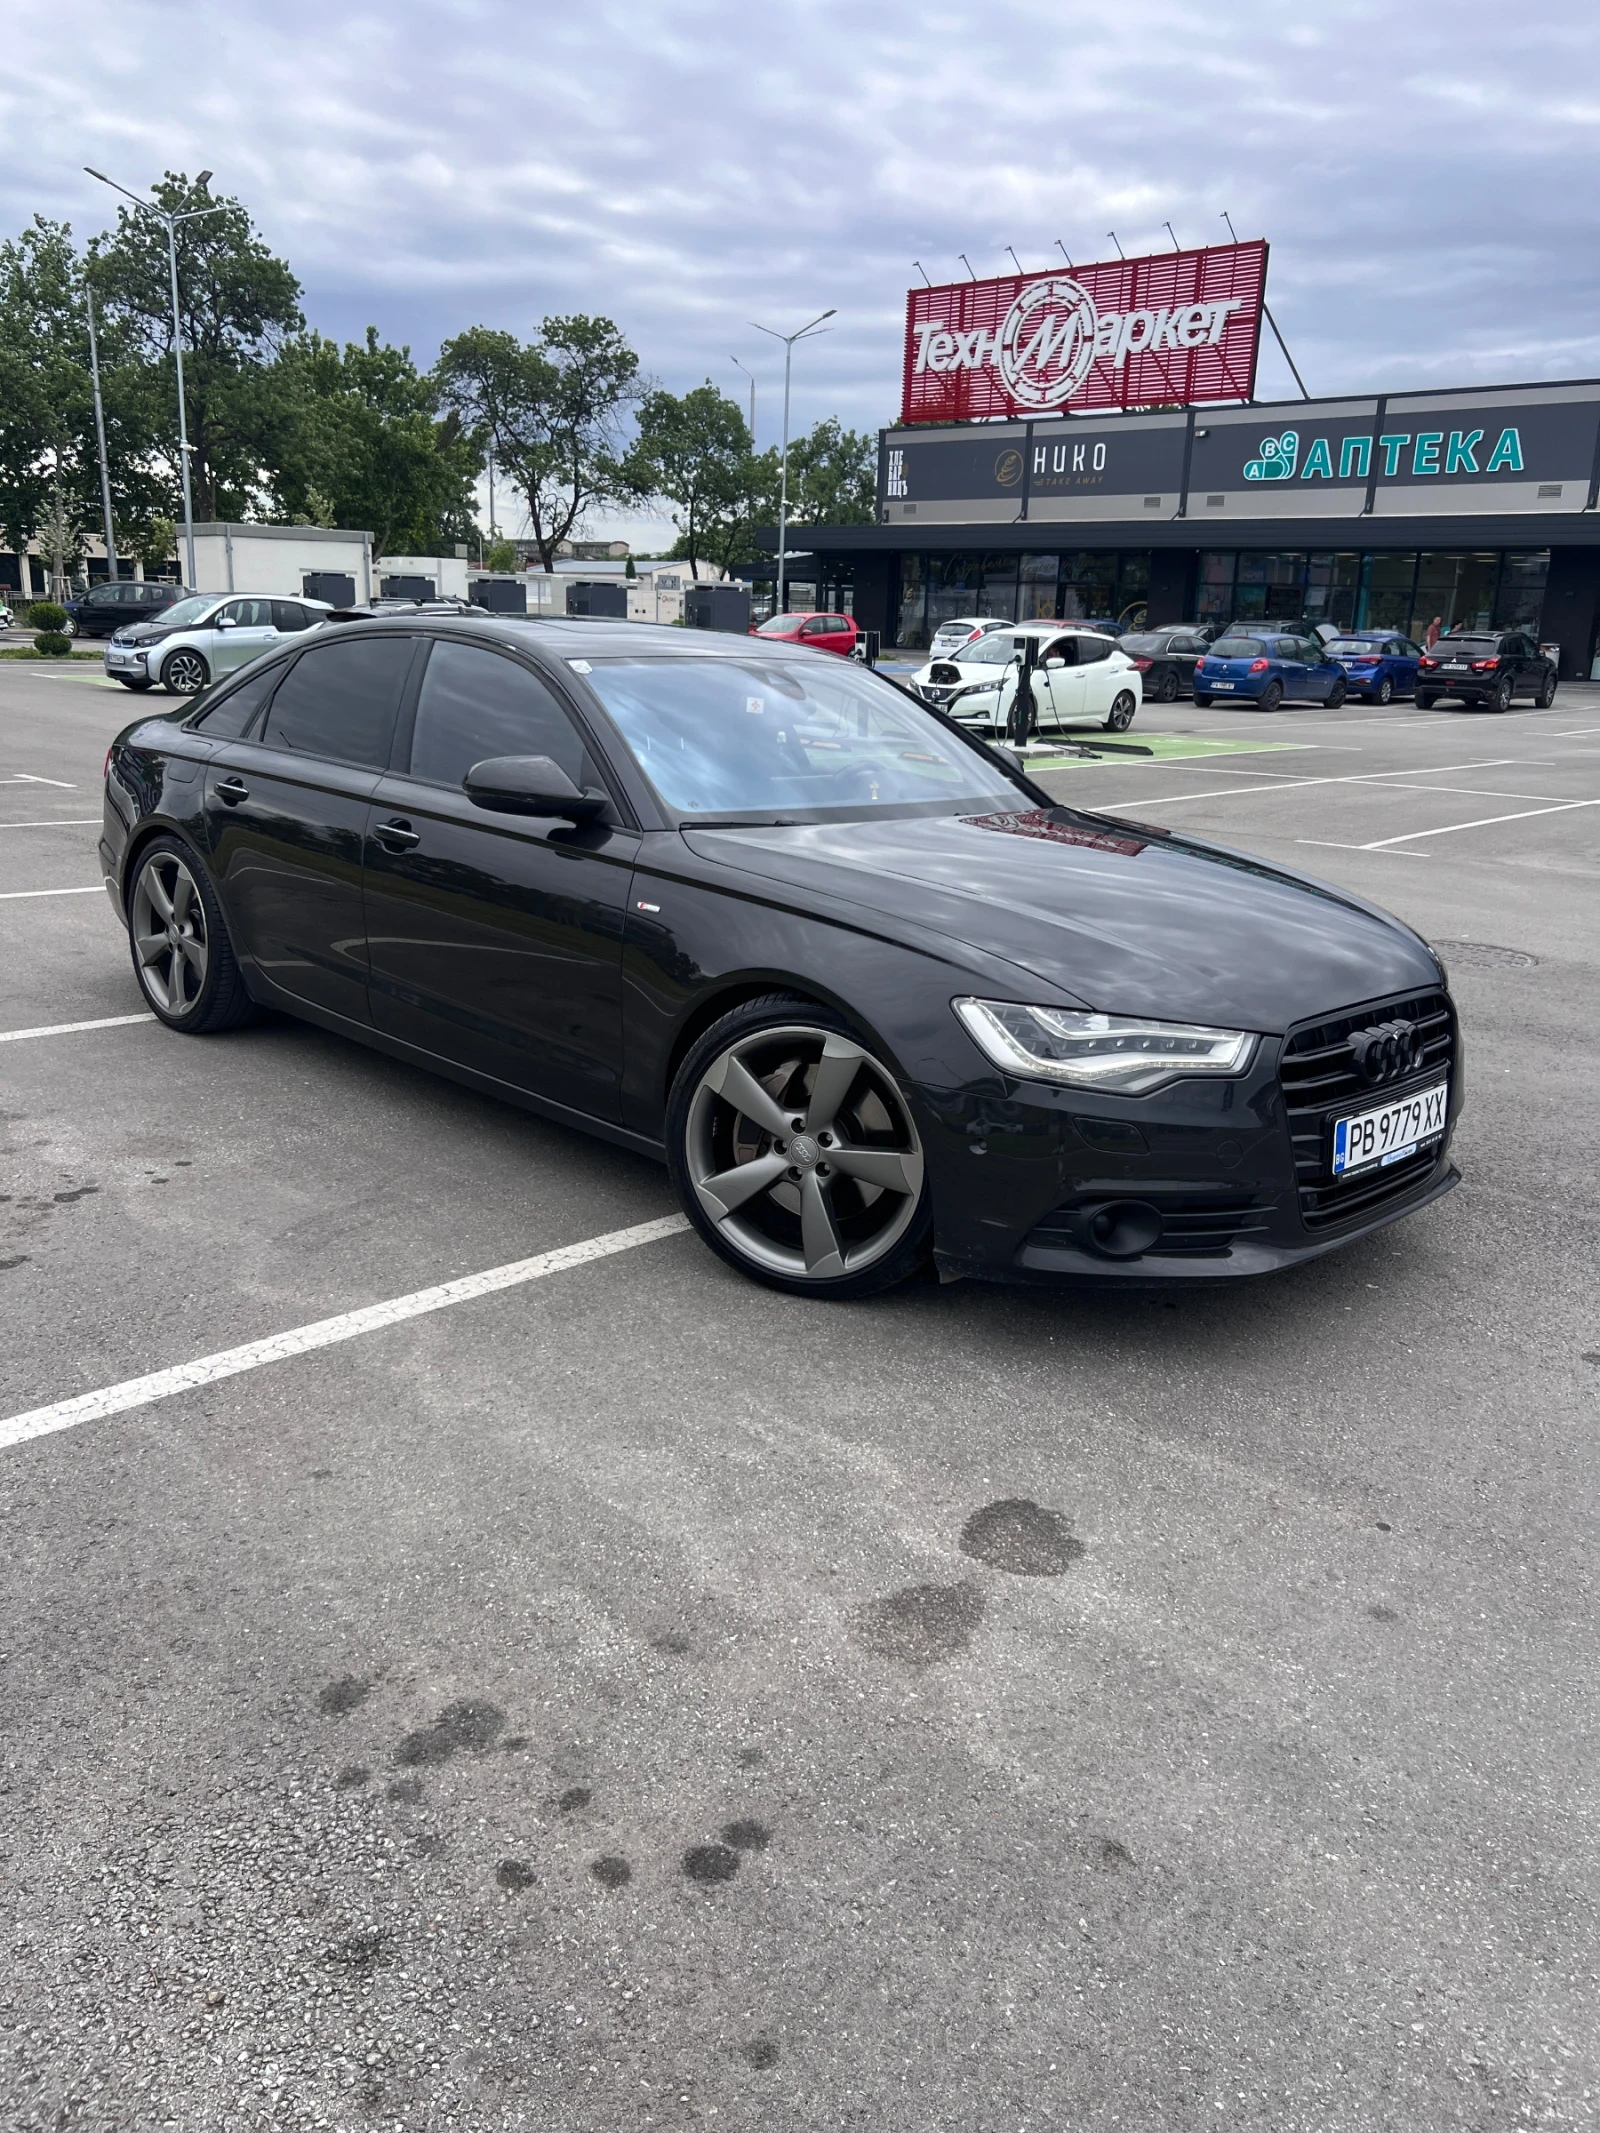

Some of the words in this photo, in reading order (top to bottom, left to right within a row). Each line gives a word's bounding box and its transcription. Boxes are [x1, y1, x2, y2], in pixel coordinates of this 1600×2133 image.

[1300, 428, 1524, 479] АПТЕКА
[1046, 477, 1071, 486] TAKE
[1075, 476, 1104, 485] AWAY
[1349, 1118, 1375, 1161] PB
[1380, 1100, 1421, 1150] 9779
[1423, 1090, 1444, 1132] XX
[1335, 1152, 1345, 1165] BG
